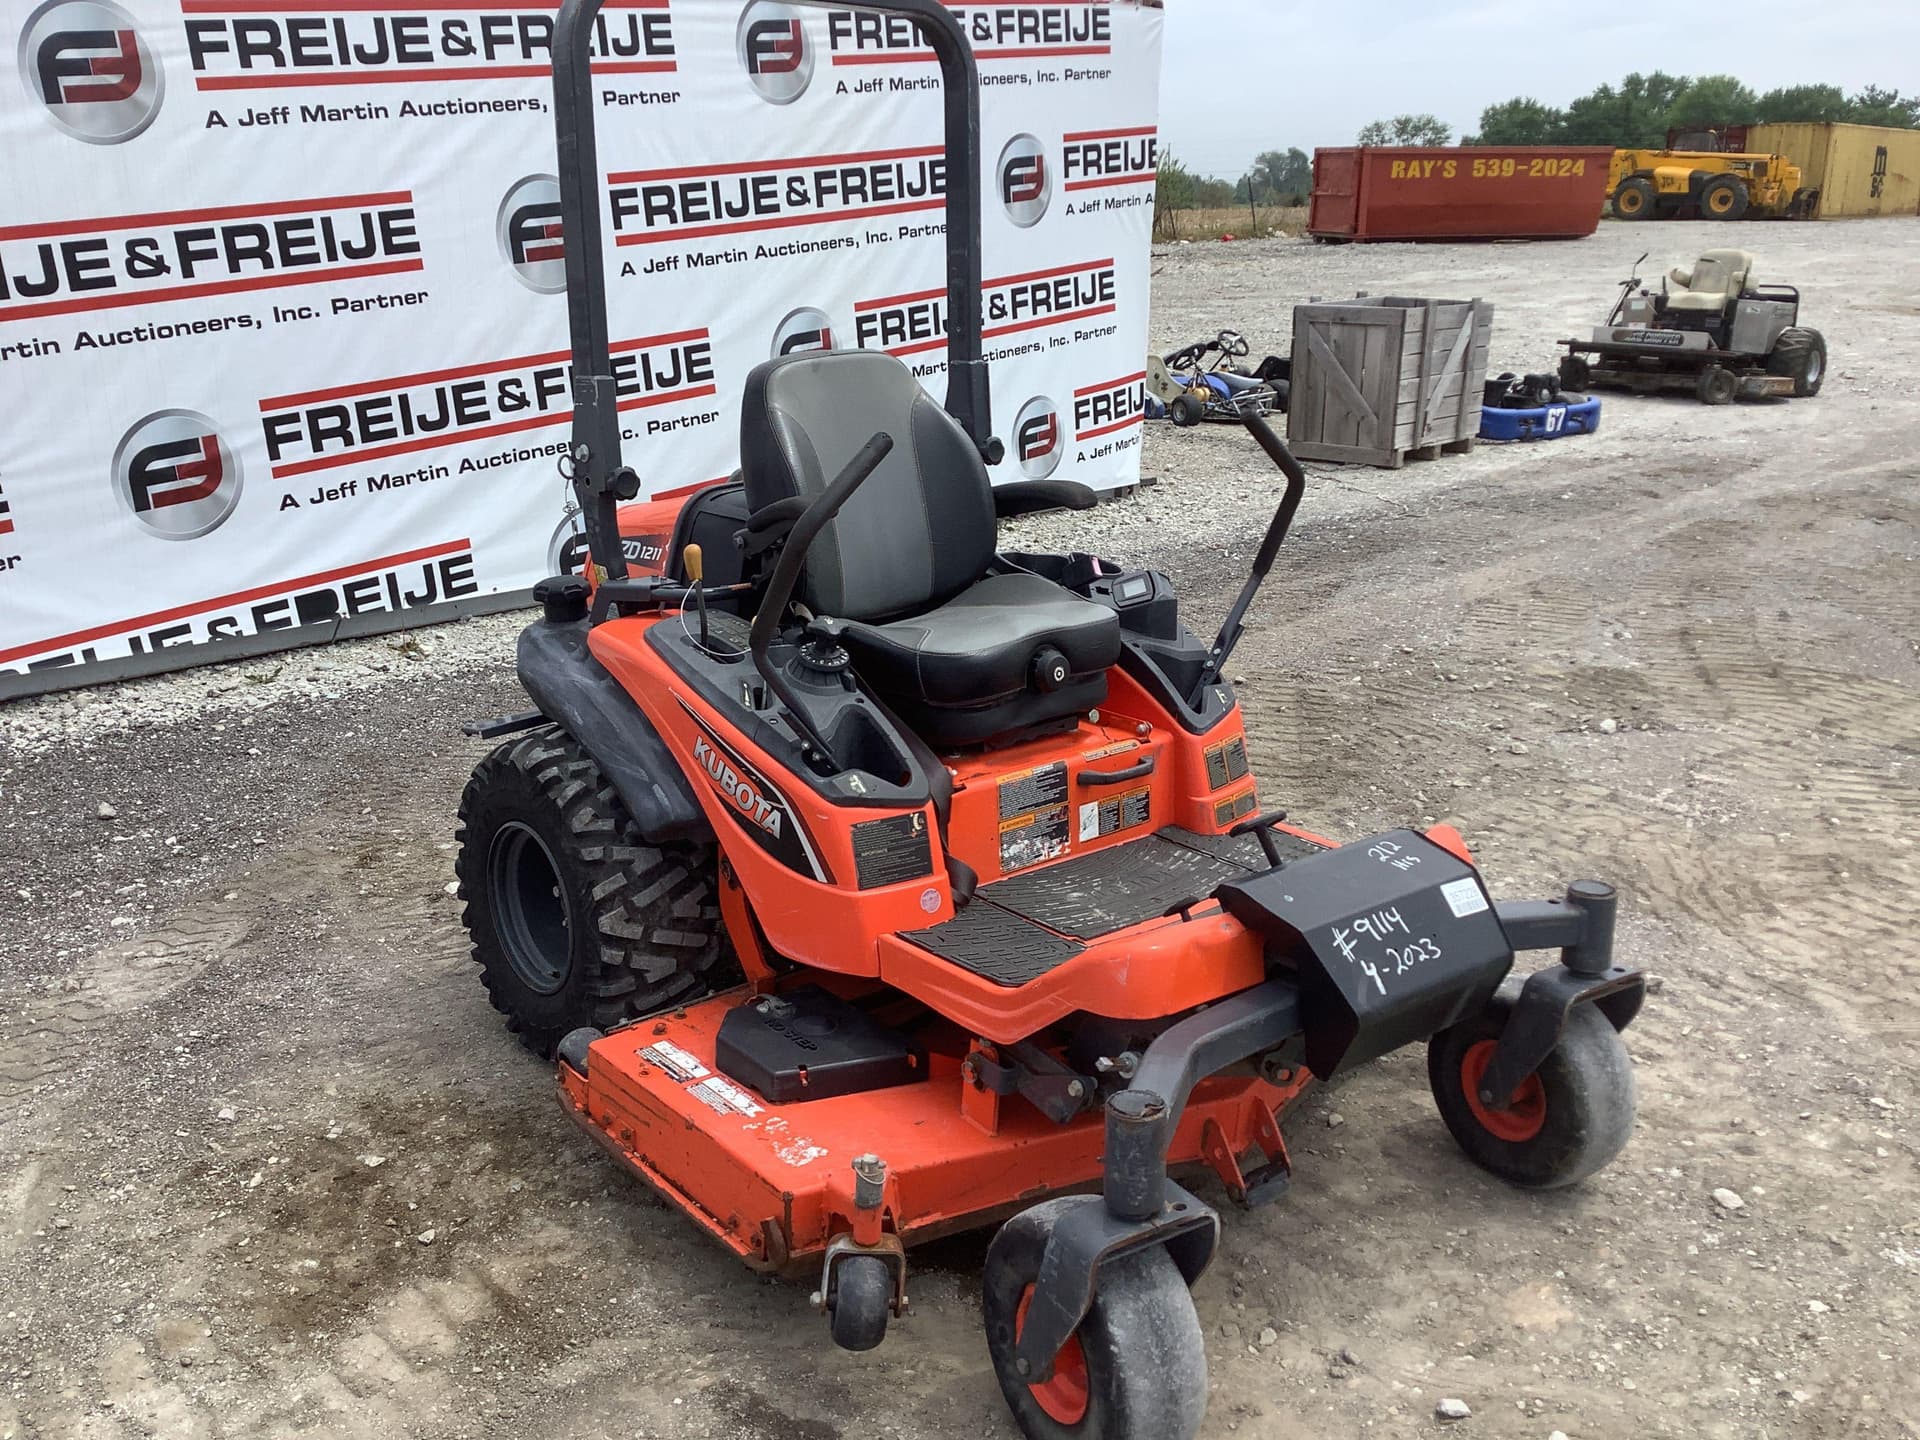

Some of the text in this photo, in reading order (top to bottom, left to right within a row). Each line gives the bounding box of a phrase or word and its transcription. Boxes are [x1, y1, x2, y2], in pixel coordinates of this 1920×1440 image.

[836, 80, 848, 94] A
[854, 78, 883, 93] Jeff
[889, 75, 939, 91] Martin
[1037, 70, 1059, 83] Inc.
[1064, 68, 1112, 81] Partner
[205, 90, 680, 128] A Jeff Martin Auctioneers, Partner
[1391, 158, 1586, 178] RAY'S 539-2024
[1066, 204, 1075, 216] A
[1079, 201, 1100, 214] Jeff
[1105, 194, 1141, 210] Martin
[620, 262, 636, 277] A
[643, 255, 679, 274] Jeff
[686, 248, 748, 269] Martin
[754, 236, 860, 260] Auctioneers,
[866, 230, 893, 245] Inc.
[74, 314, 262, 351] Auctioneers,
[273, 305, 320, 323] Inc.
[331, 291, 428, 315] Partner
[1050, 336, 1070, 349] Inc.
[1074, 326, 1117, 343] Partner
[1545, 408, 1566, 432] 67
[280, 494, 300, 511] A
[309, 481, 357, 504] Jeff
[367, 465, 449, 492] Martin
[647, 411, 719, 435] Partner
[1077, 452, 1086, 463] A
[1090, 444, 1112, 459] Jeff
[693, 735, 782, 840] KUBOTA
[1368, 841, 1403, 863] 212
[1361, 938, 1441, 995] 4-2023
[764, 1018, 818, 1051] NO STEP
